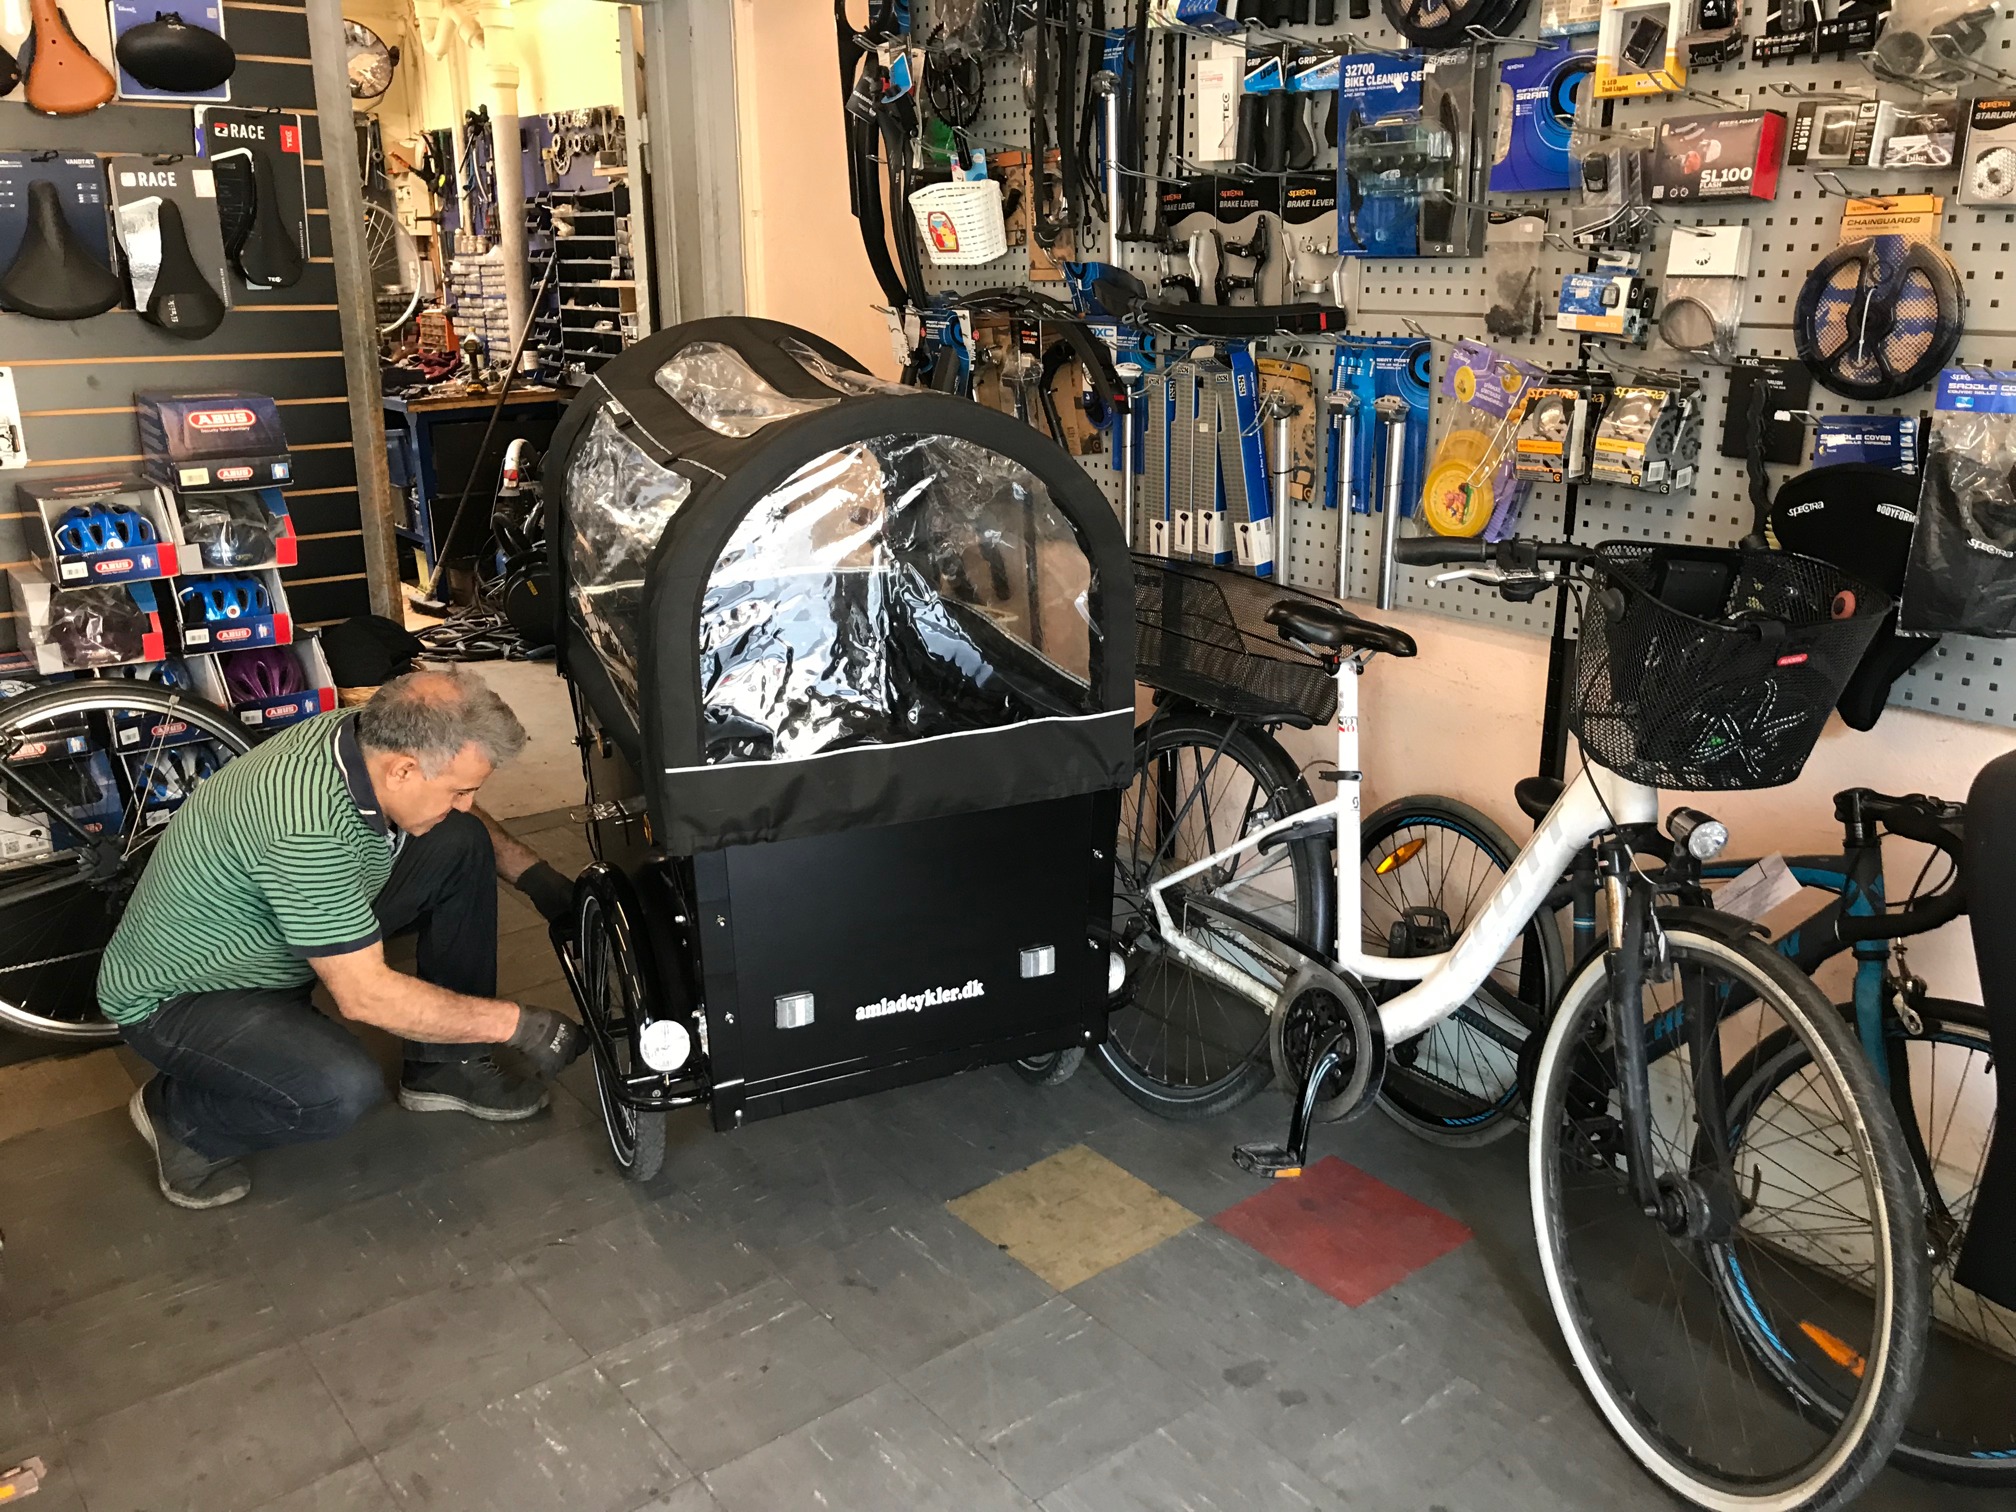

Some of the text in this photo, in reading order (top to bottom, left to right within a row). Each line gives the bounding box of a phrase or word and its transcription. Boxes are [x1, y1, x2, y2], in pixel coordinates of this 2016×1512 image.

[1247, 58, 1261, 66] GRIP
[1298, 56, 1317, 65] GRIP
[1345, 63, 1375, 77] 32700
[1344, 71, 1427, 88] BIKE CLEANING SET
[1516, 91, 1549, 100] SRAM
[230, 123, 266, 140] RACE
[1797, 117, 1812, 151] MICRO
[1906, 154, 1927, 162] bike
[137, 171, 177, 187] RACE
[1700, 167, 1753, 182] SL100
[1178, 202, 1195, 210] LEVER
[1219, 200, 1259, 208] BRAKE LEVER
[1286, 198, 1335, 208] BRAKE LEVER
[1847, 217, 1921, 226] CHAINGUARDS
[1570, 278, 1593, 287] Echo
[1948, 382, 1998, 391] SADDLE
[198, 413, 248, 426] ABUS
[223, 469, 249, 477] ABUS
[1876, 504, 1916, 523] BODYFORM
[101, 561, 129, 571] ABUS
[221, 629, 247, 638] ABUS
[268, 705, 296, 716] ABUS
[156, 723, 183, 735] ABUS
[855, 979, 985, 1021] amladcykler.dk
